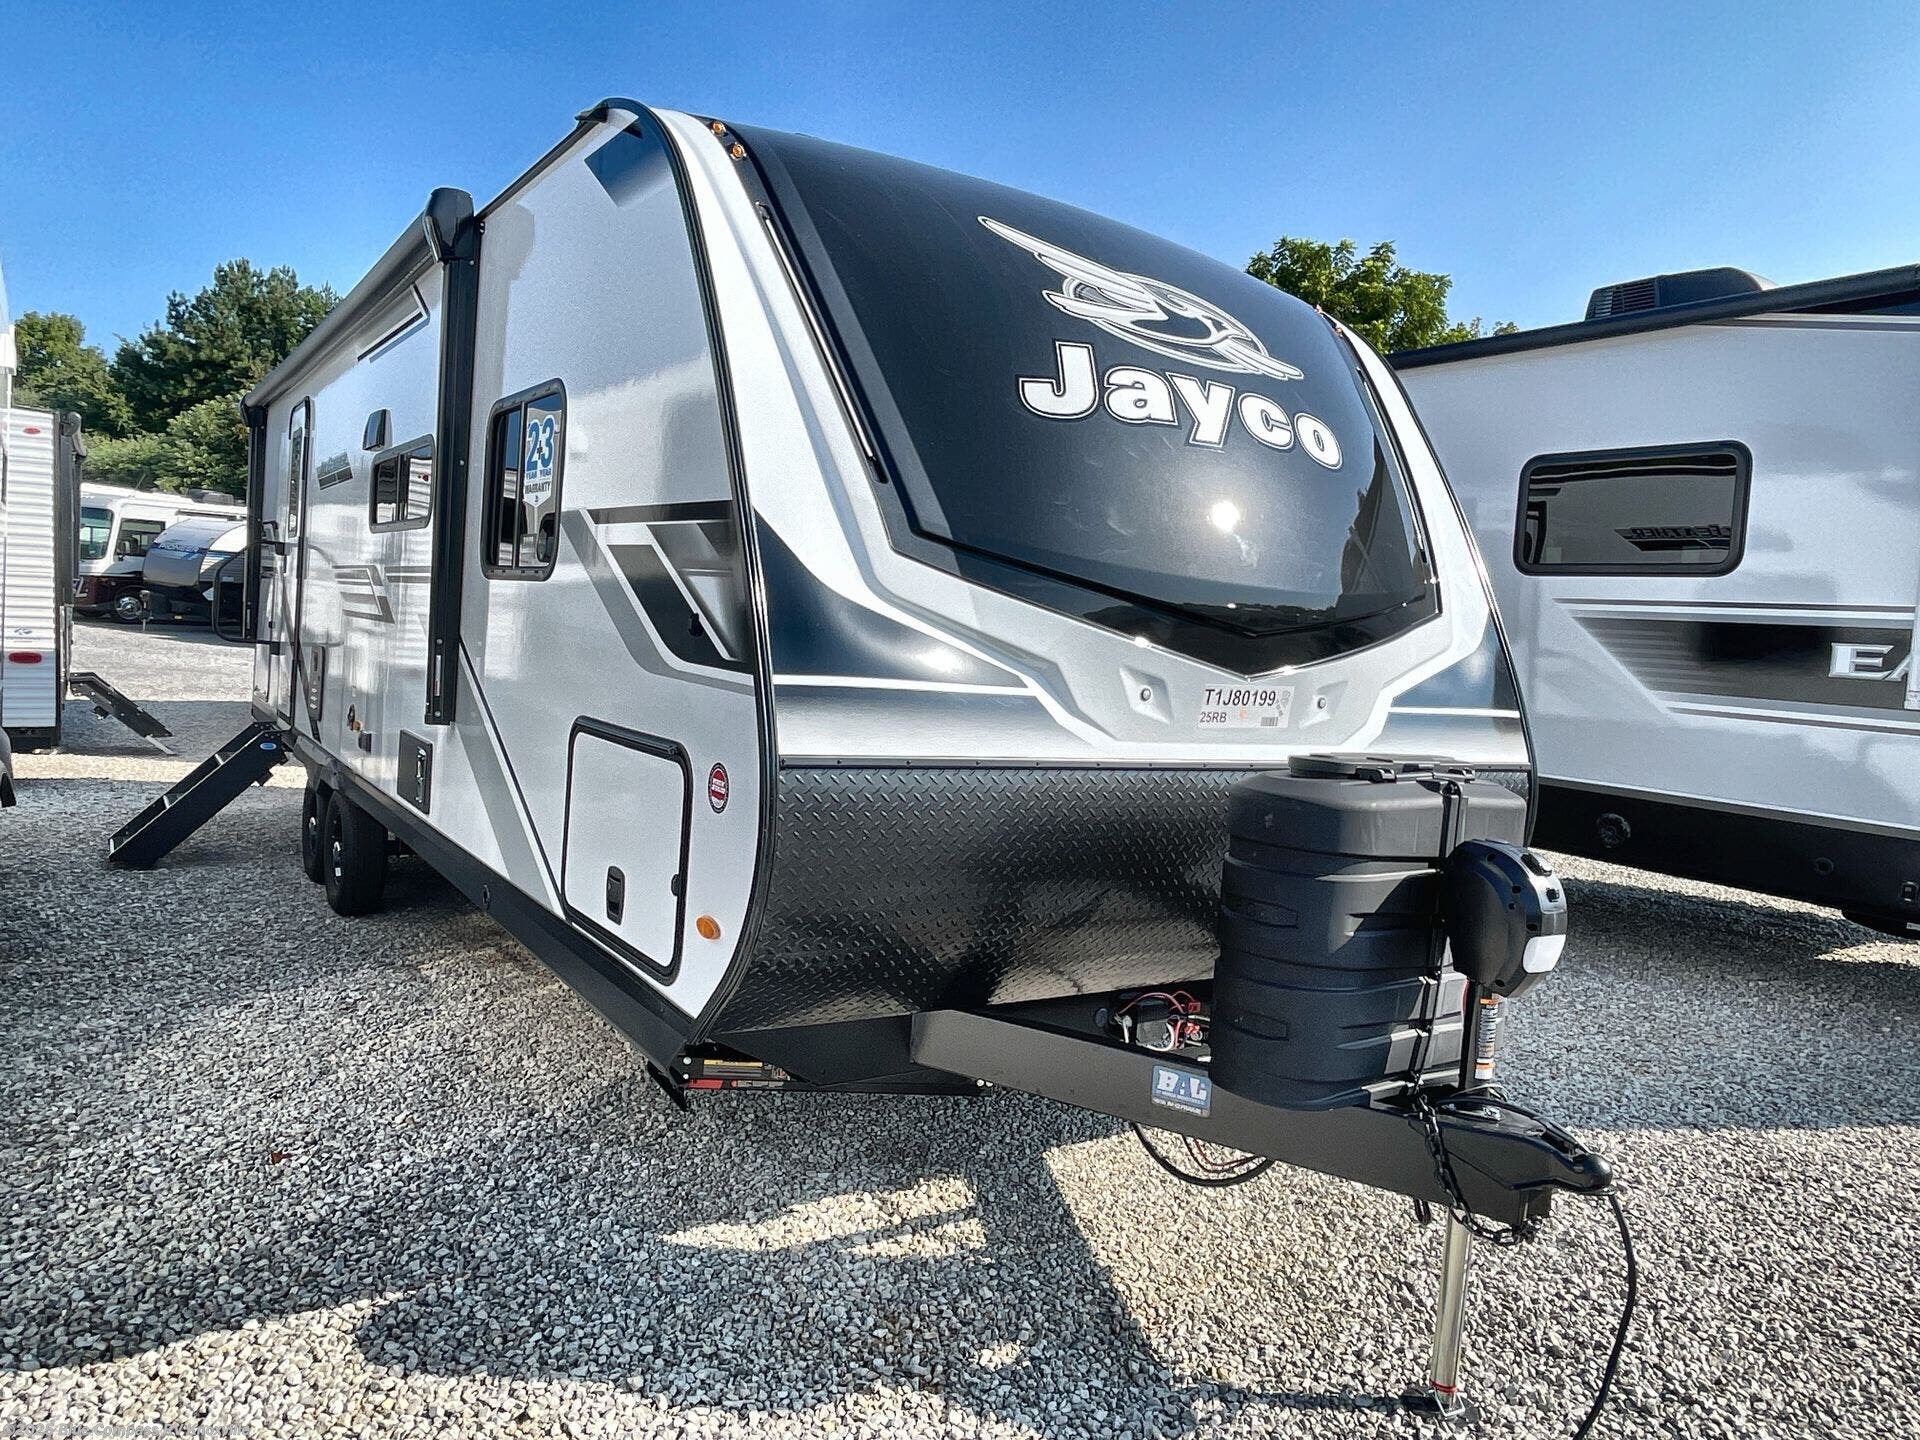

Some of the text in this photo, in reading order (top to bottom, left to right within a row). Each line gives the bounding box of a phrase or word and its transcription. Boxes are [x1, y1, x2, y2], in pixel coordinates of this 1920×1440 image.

[1019, 341, 1343, 470] Jayco
[1205, 689, 1276, 706] T1J80199
[1200, 711, 1227, 723] 25RB
